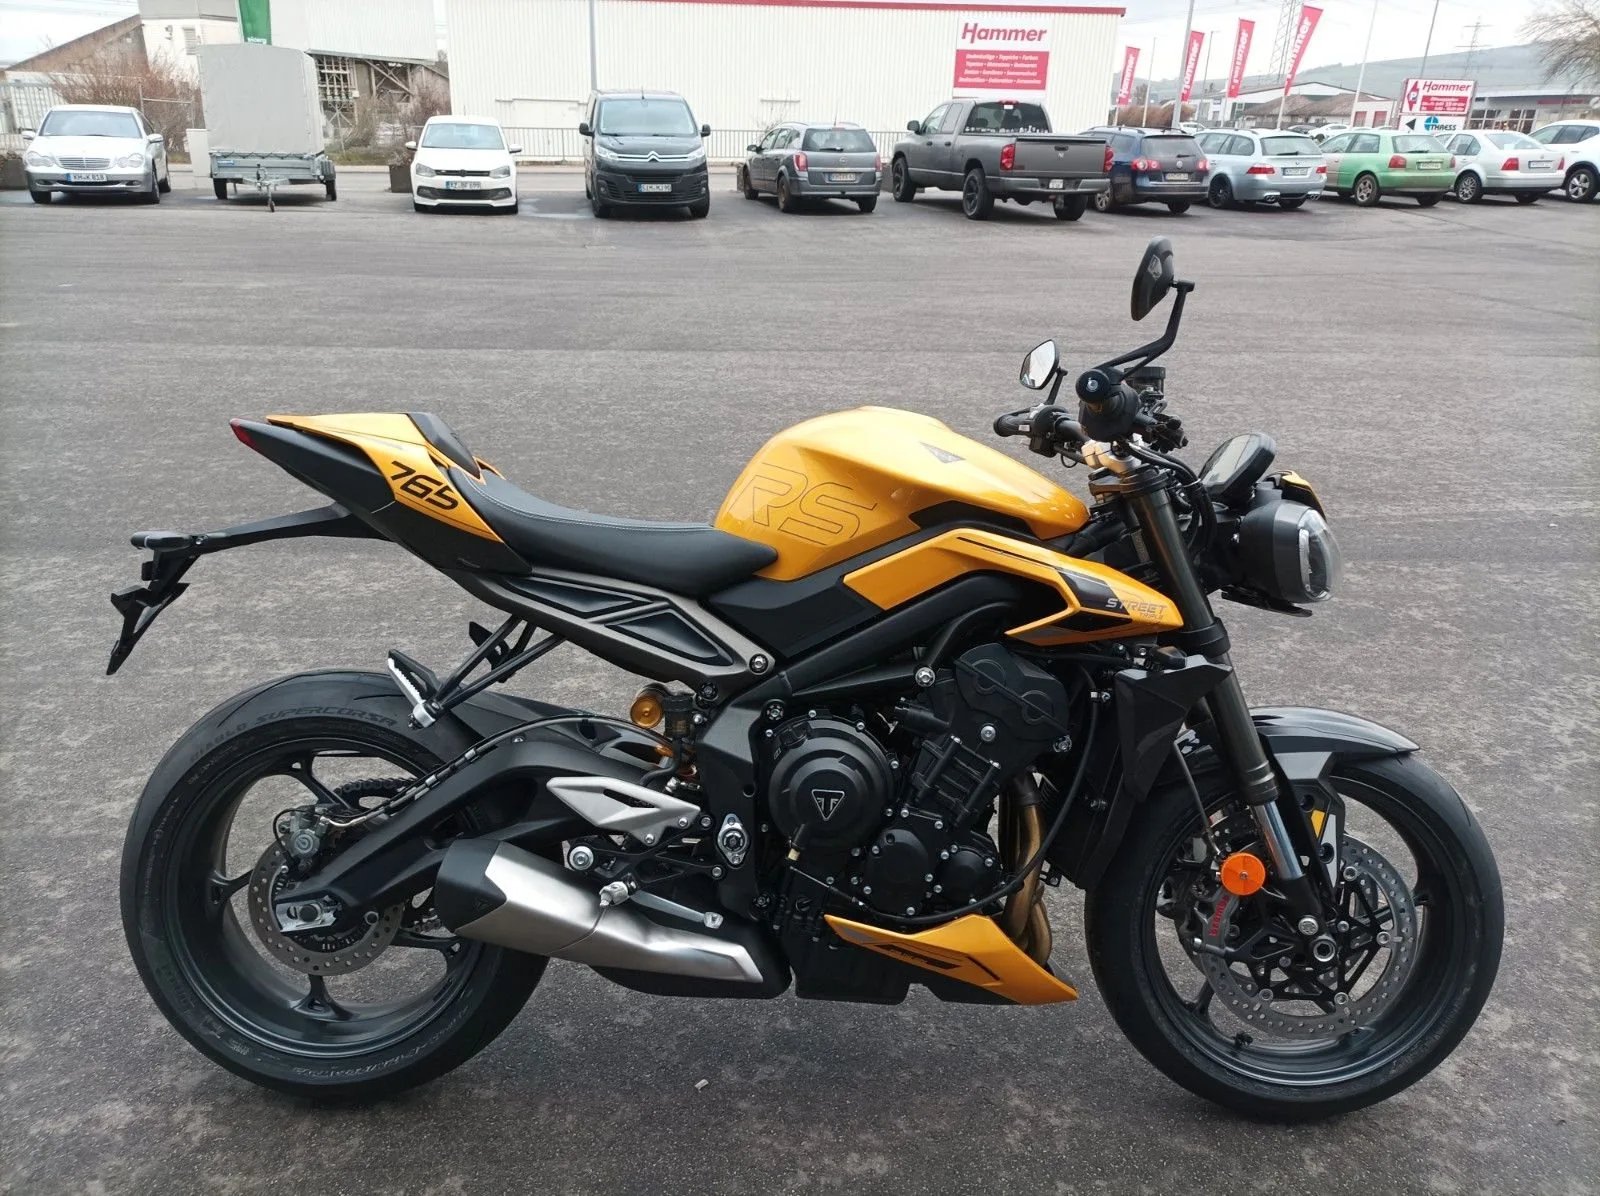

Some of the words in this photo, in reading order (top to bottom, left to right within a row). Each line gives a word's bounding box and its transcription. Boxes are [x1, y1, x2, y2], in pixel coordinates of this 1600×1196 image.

[961, 22, 1047, 44] Hammer
[1422, 80, 1472, 93] Hammer
[391, 460, 459, 511] 765
[728, 462, 878, 546] RS
[1105, 598, 1167, 614] STREET
[255, 705, 399, 728] SUPERCORSA
[1207, 894, 1230, 937] brembo
